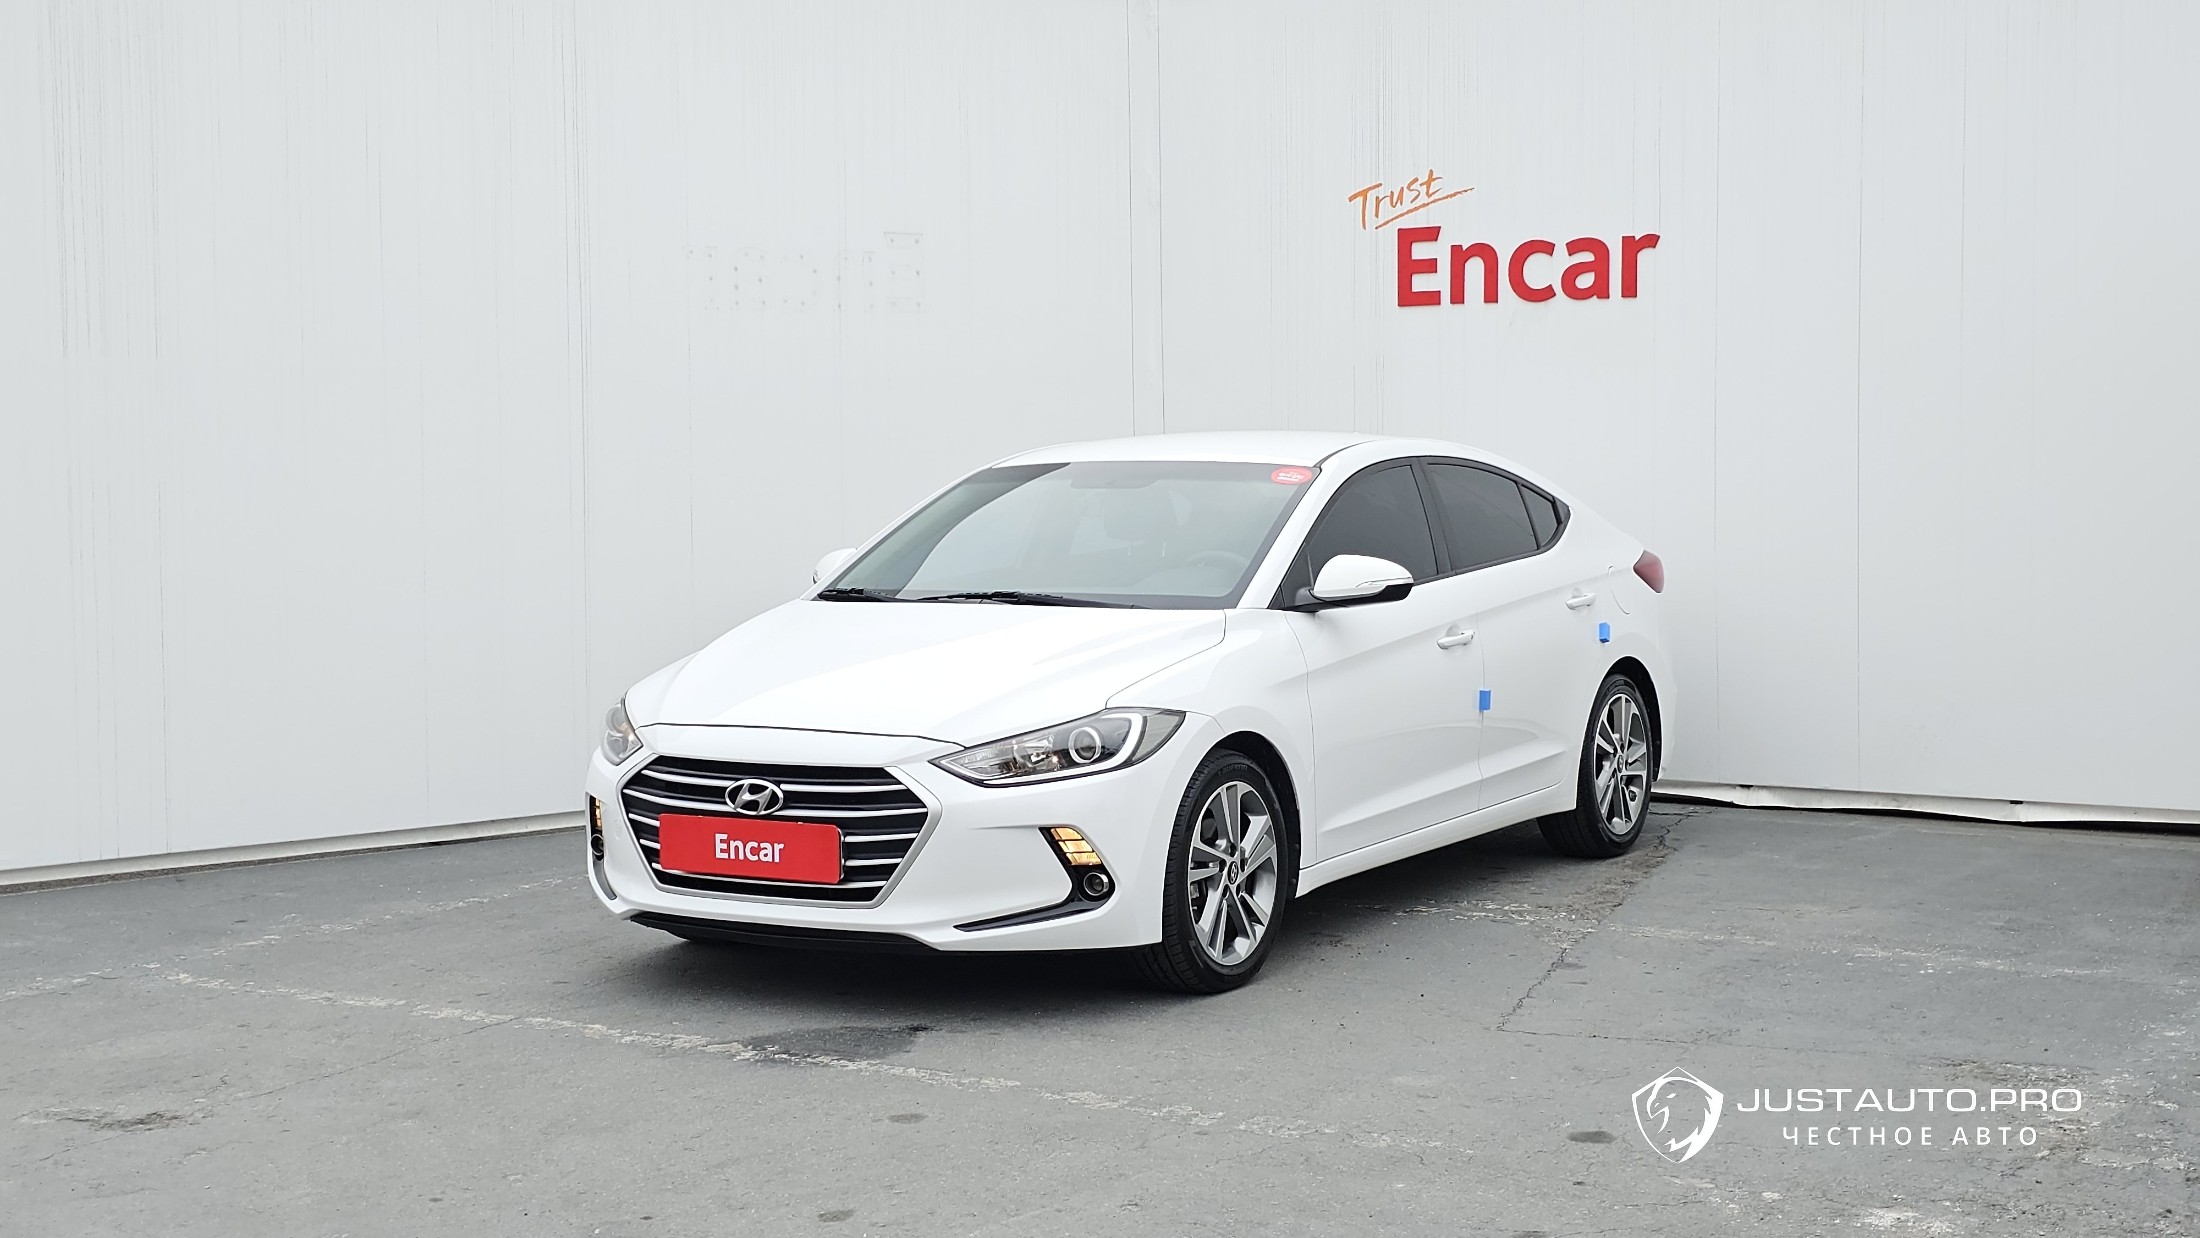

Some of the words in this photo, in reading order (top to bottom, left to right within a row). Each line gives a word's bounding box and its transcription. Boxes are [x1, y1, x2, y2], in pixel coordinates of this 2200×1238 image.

[1348, 169, 1444, 230] Trust
[1397, 226, 1661, 307] Encar
[715, 833, 785, 863] Encar
